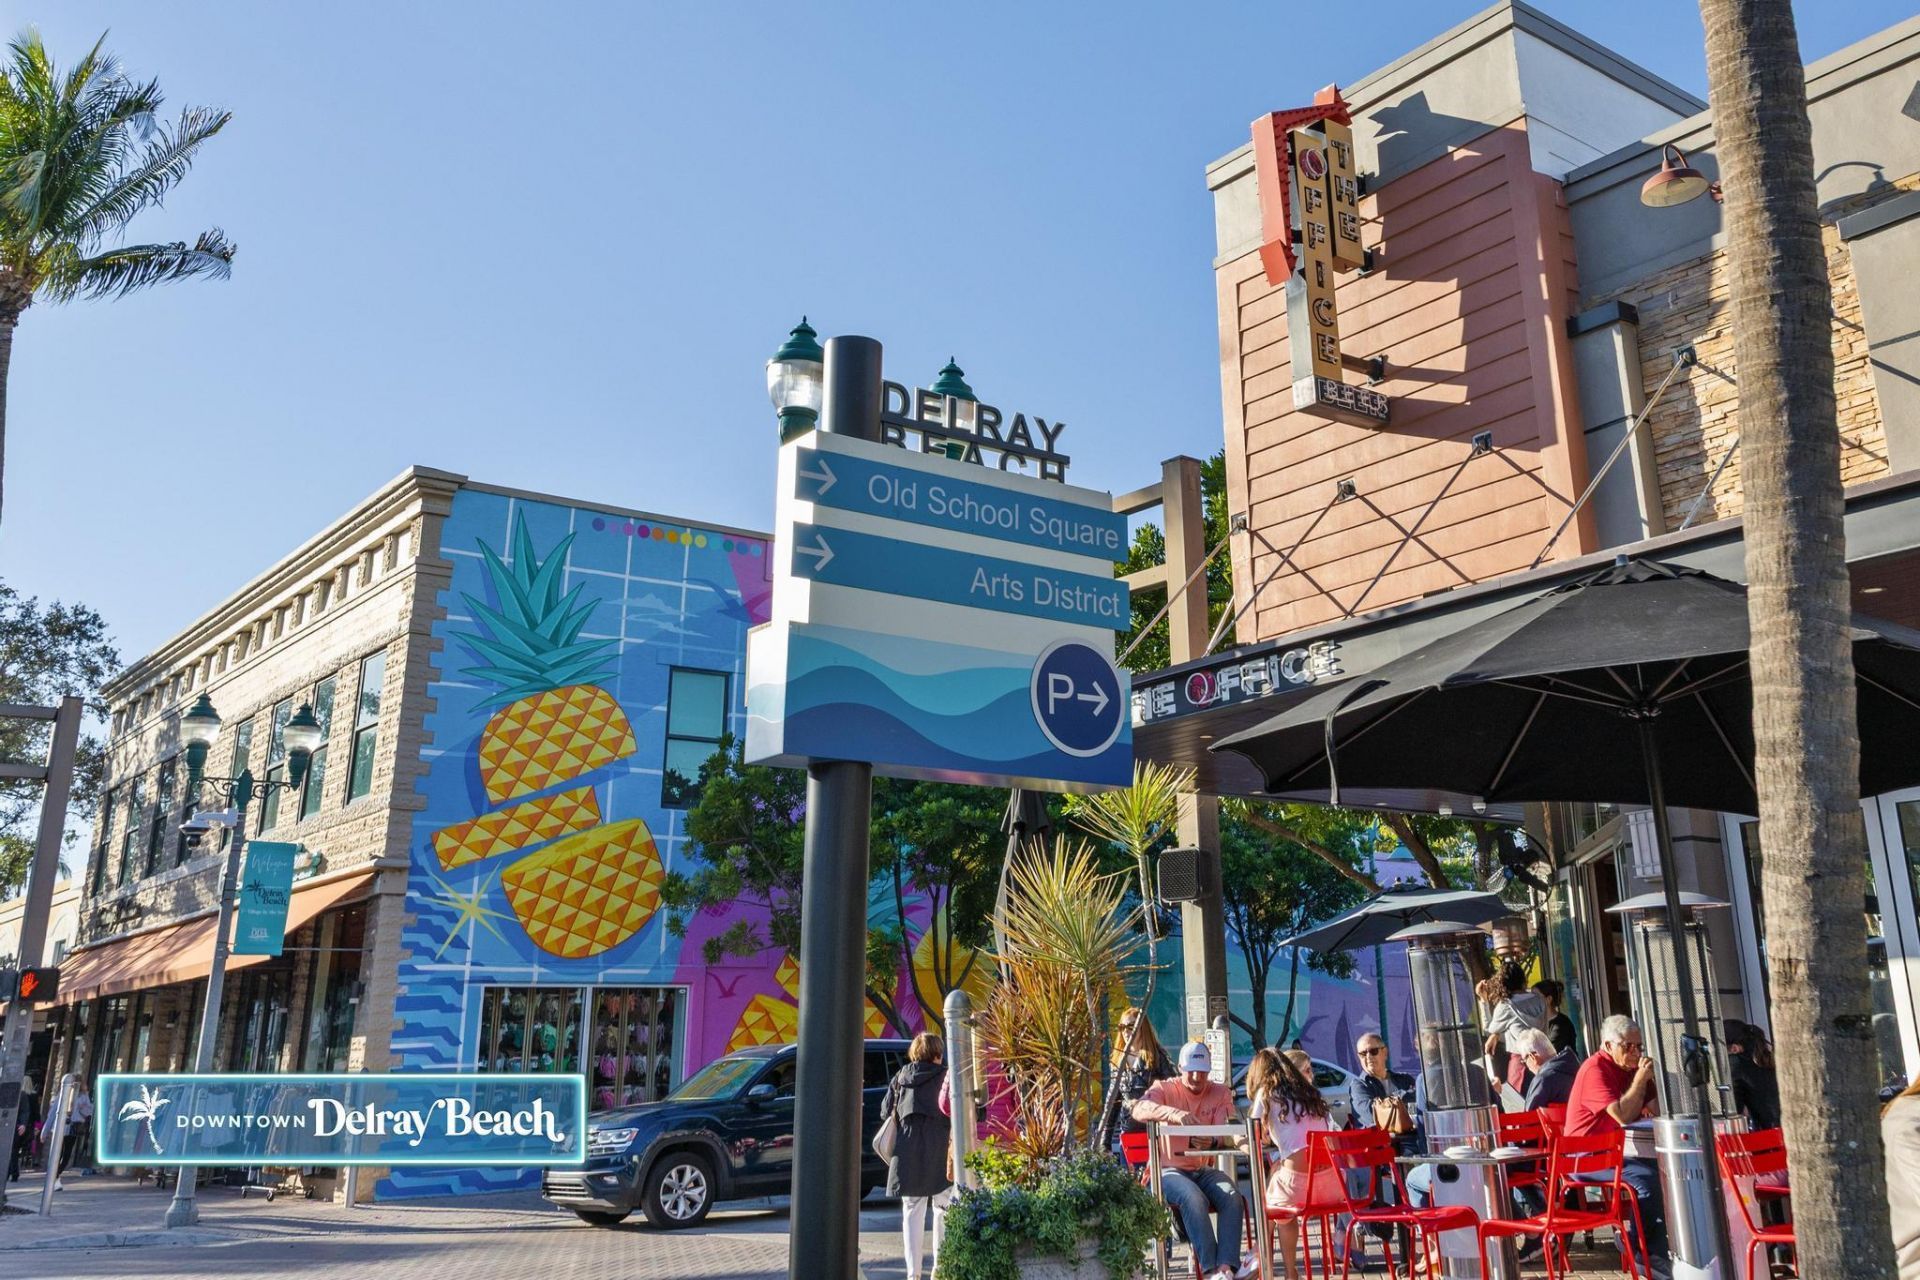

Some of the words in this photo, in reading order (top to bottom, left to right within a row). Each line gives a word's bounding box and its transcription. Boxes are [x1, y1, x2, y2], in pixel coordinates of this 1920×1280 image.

[1331, 139, 1360, 243] THE
[1298, 146, 1339, 366] OFFICE
[881, 379, 1067, 454] DELRAY
[868, 474, 917, 510] Old
[928, 486, 1020, 530] School
[1029, 507, 1119, 550] Square
[970, 566, 1024, 601] Arts
[1034, 577, 1121, 618] District
[1048, 672, 1075, 715] P
[1185, 639, 1343, 707] OFFICE
